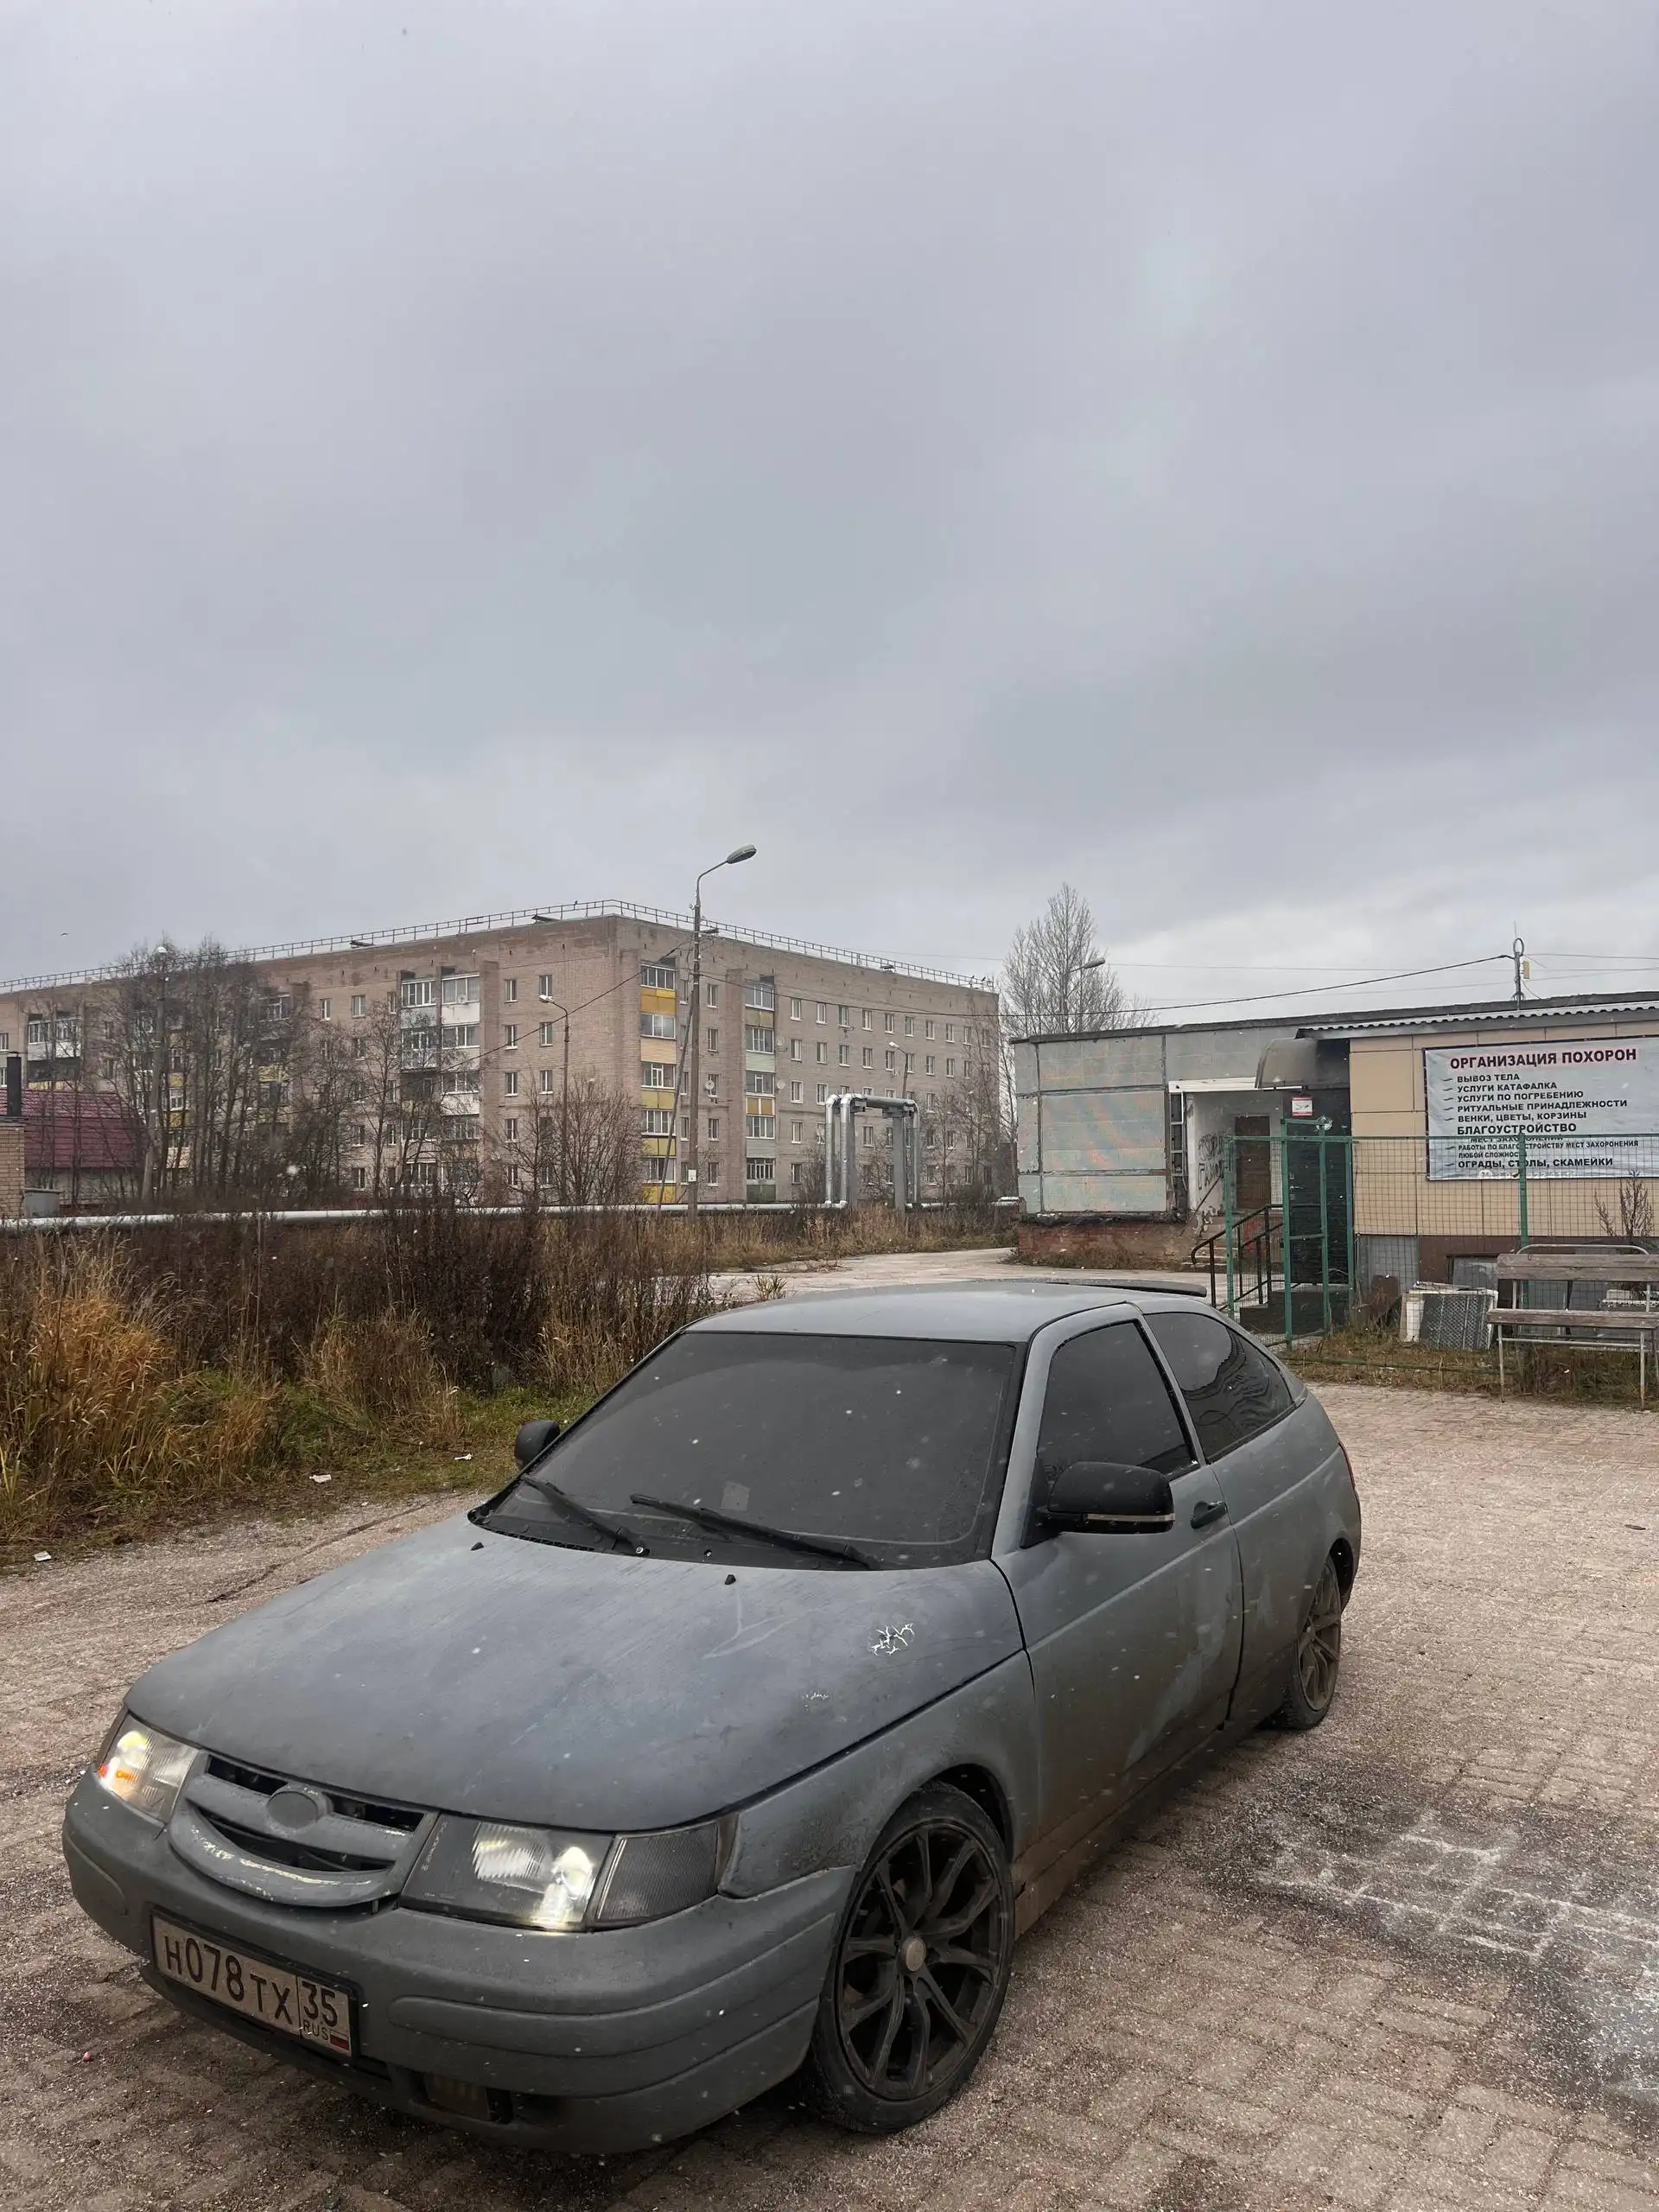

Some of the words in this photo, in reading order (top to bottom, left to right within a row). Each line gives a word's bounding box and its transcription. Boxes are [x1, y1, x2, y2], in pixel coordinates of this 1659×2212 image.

[1450, 1052, 1557, 1070] ОРГАНИЗАЦИЯ
[1561, 1048, 1637, 1064] ПОХОРОН
[1457, 1084, 1494, 1093] УСЛУГИ
[1497, 1082, 1557, 1091] КАТАФАЛКА
[1457, 1094, 1494, 1103] УСЛУГИ
[1514, 1090, 1584, 1100] ПОГРЕБЕНИЮ
[1457, 1103, 1524, 1113] РИТУАЛЬНЫЕ
[1527, 1099, 1627, 1110] ПРИНАДЛЕЖНОСТИ
[1458, 1115, 1493, 1123] ВЕНКИ,
[1496, 1113, 1534, 1122] ЦВЕТЫ,
[1537, 1111, 1586, 1121] КОРЗИНЫ
[1457, 1122, 1577, 1135] БЛАГОУСТРОЙСТВО
[1498, 1141, 1564, 1150] БЛАГОСТРОЙСТВУ
[1458, 1160, 1505, 1169] ОГРАДЫ,
[1553, 1157, 1613, 1166] СКАМЕЙКИ
[302, 1980, 338, 2027] 35
[302, 2018, 329, 2041] RUS
